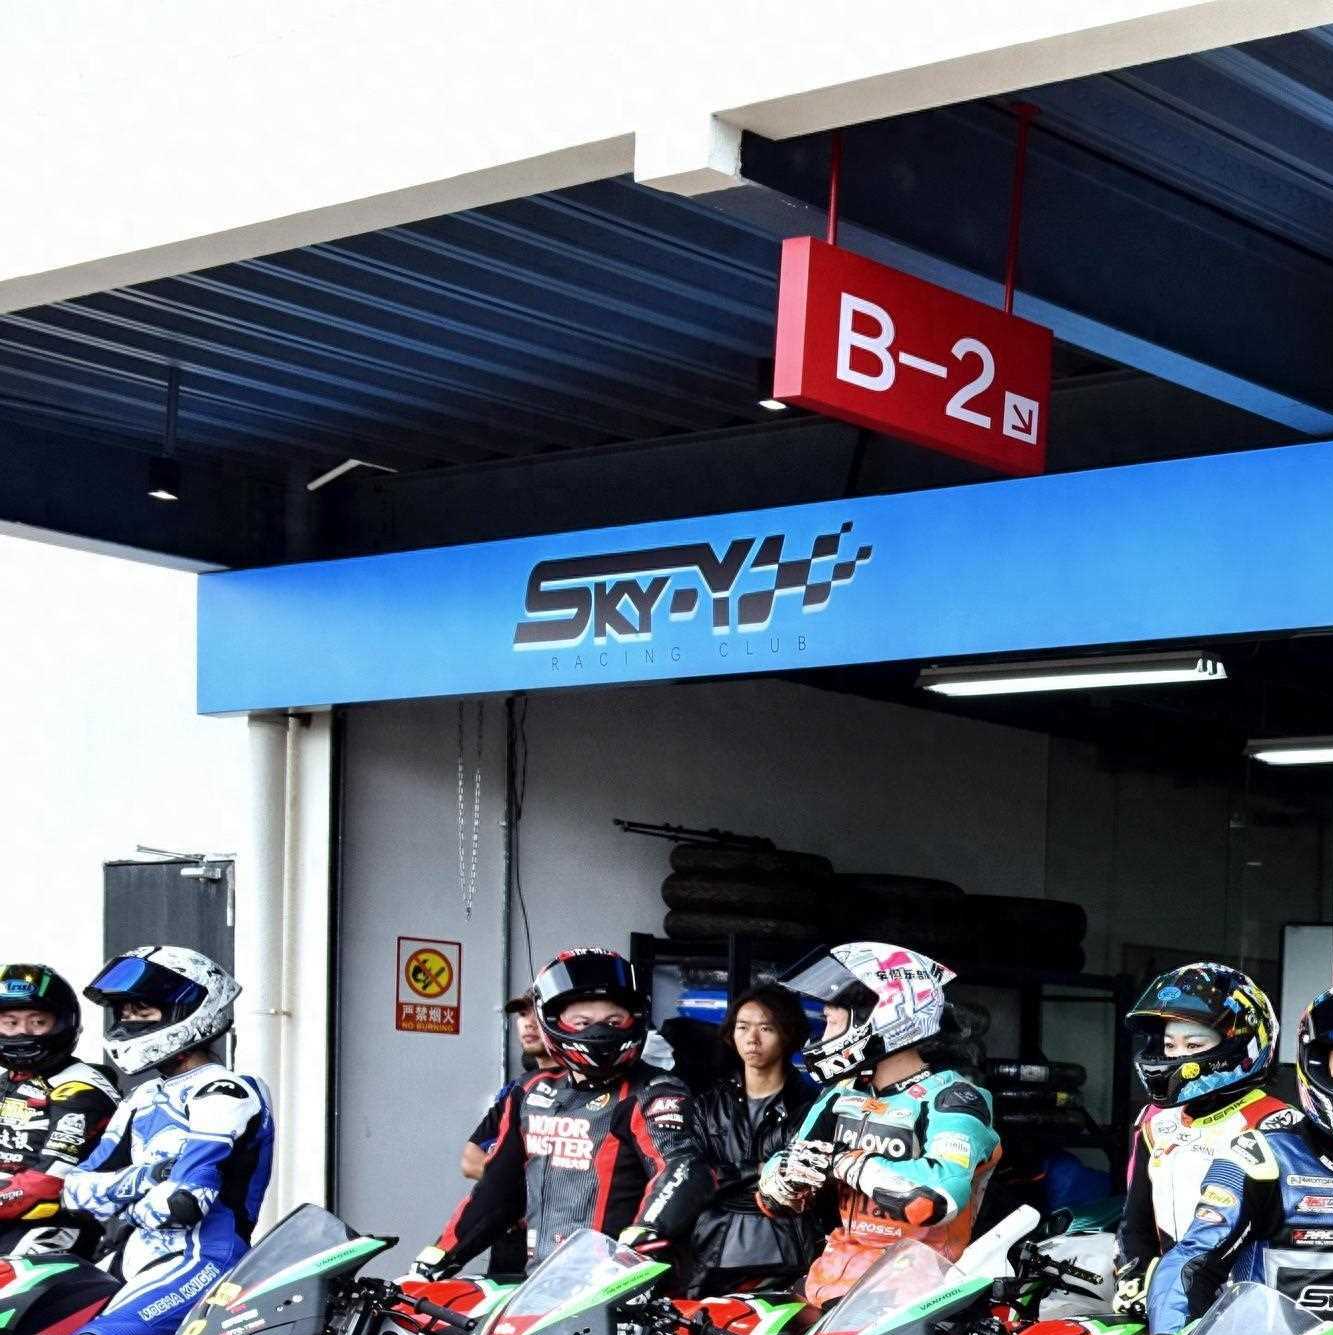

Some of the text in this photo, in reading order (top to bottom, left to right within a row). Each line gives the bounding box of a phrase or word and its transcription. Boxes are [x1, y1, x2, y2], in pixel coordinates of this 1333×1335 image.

[835, 291, 996, 429] B-2
[551, 635, 808, 671] RACING CLUB
[402, 1004, 454, 1024] 严禁烟火
[815, 1037, 867, 1080] KYT
[181, 1261, 222, 1304] KNIGHT
[919, 1287, 963, 1312] VANHOOL
